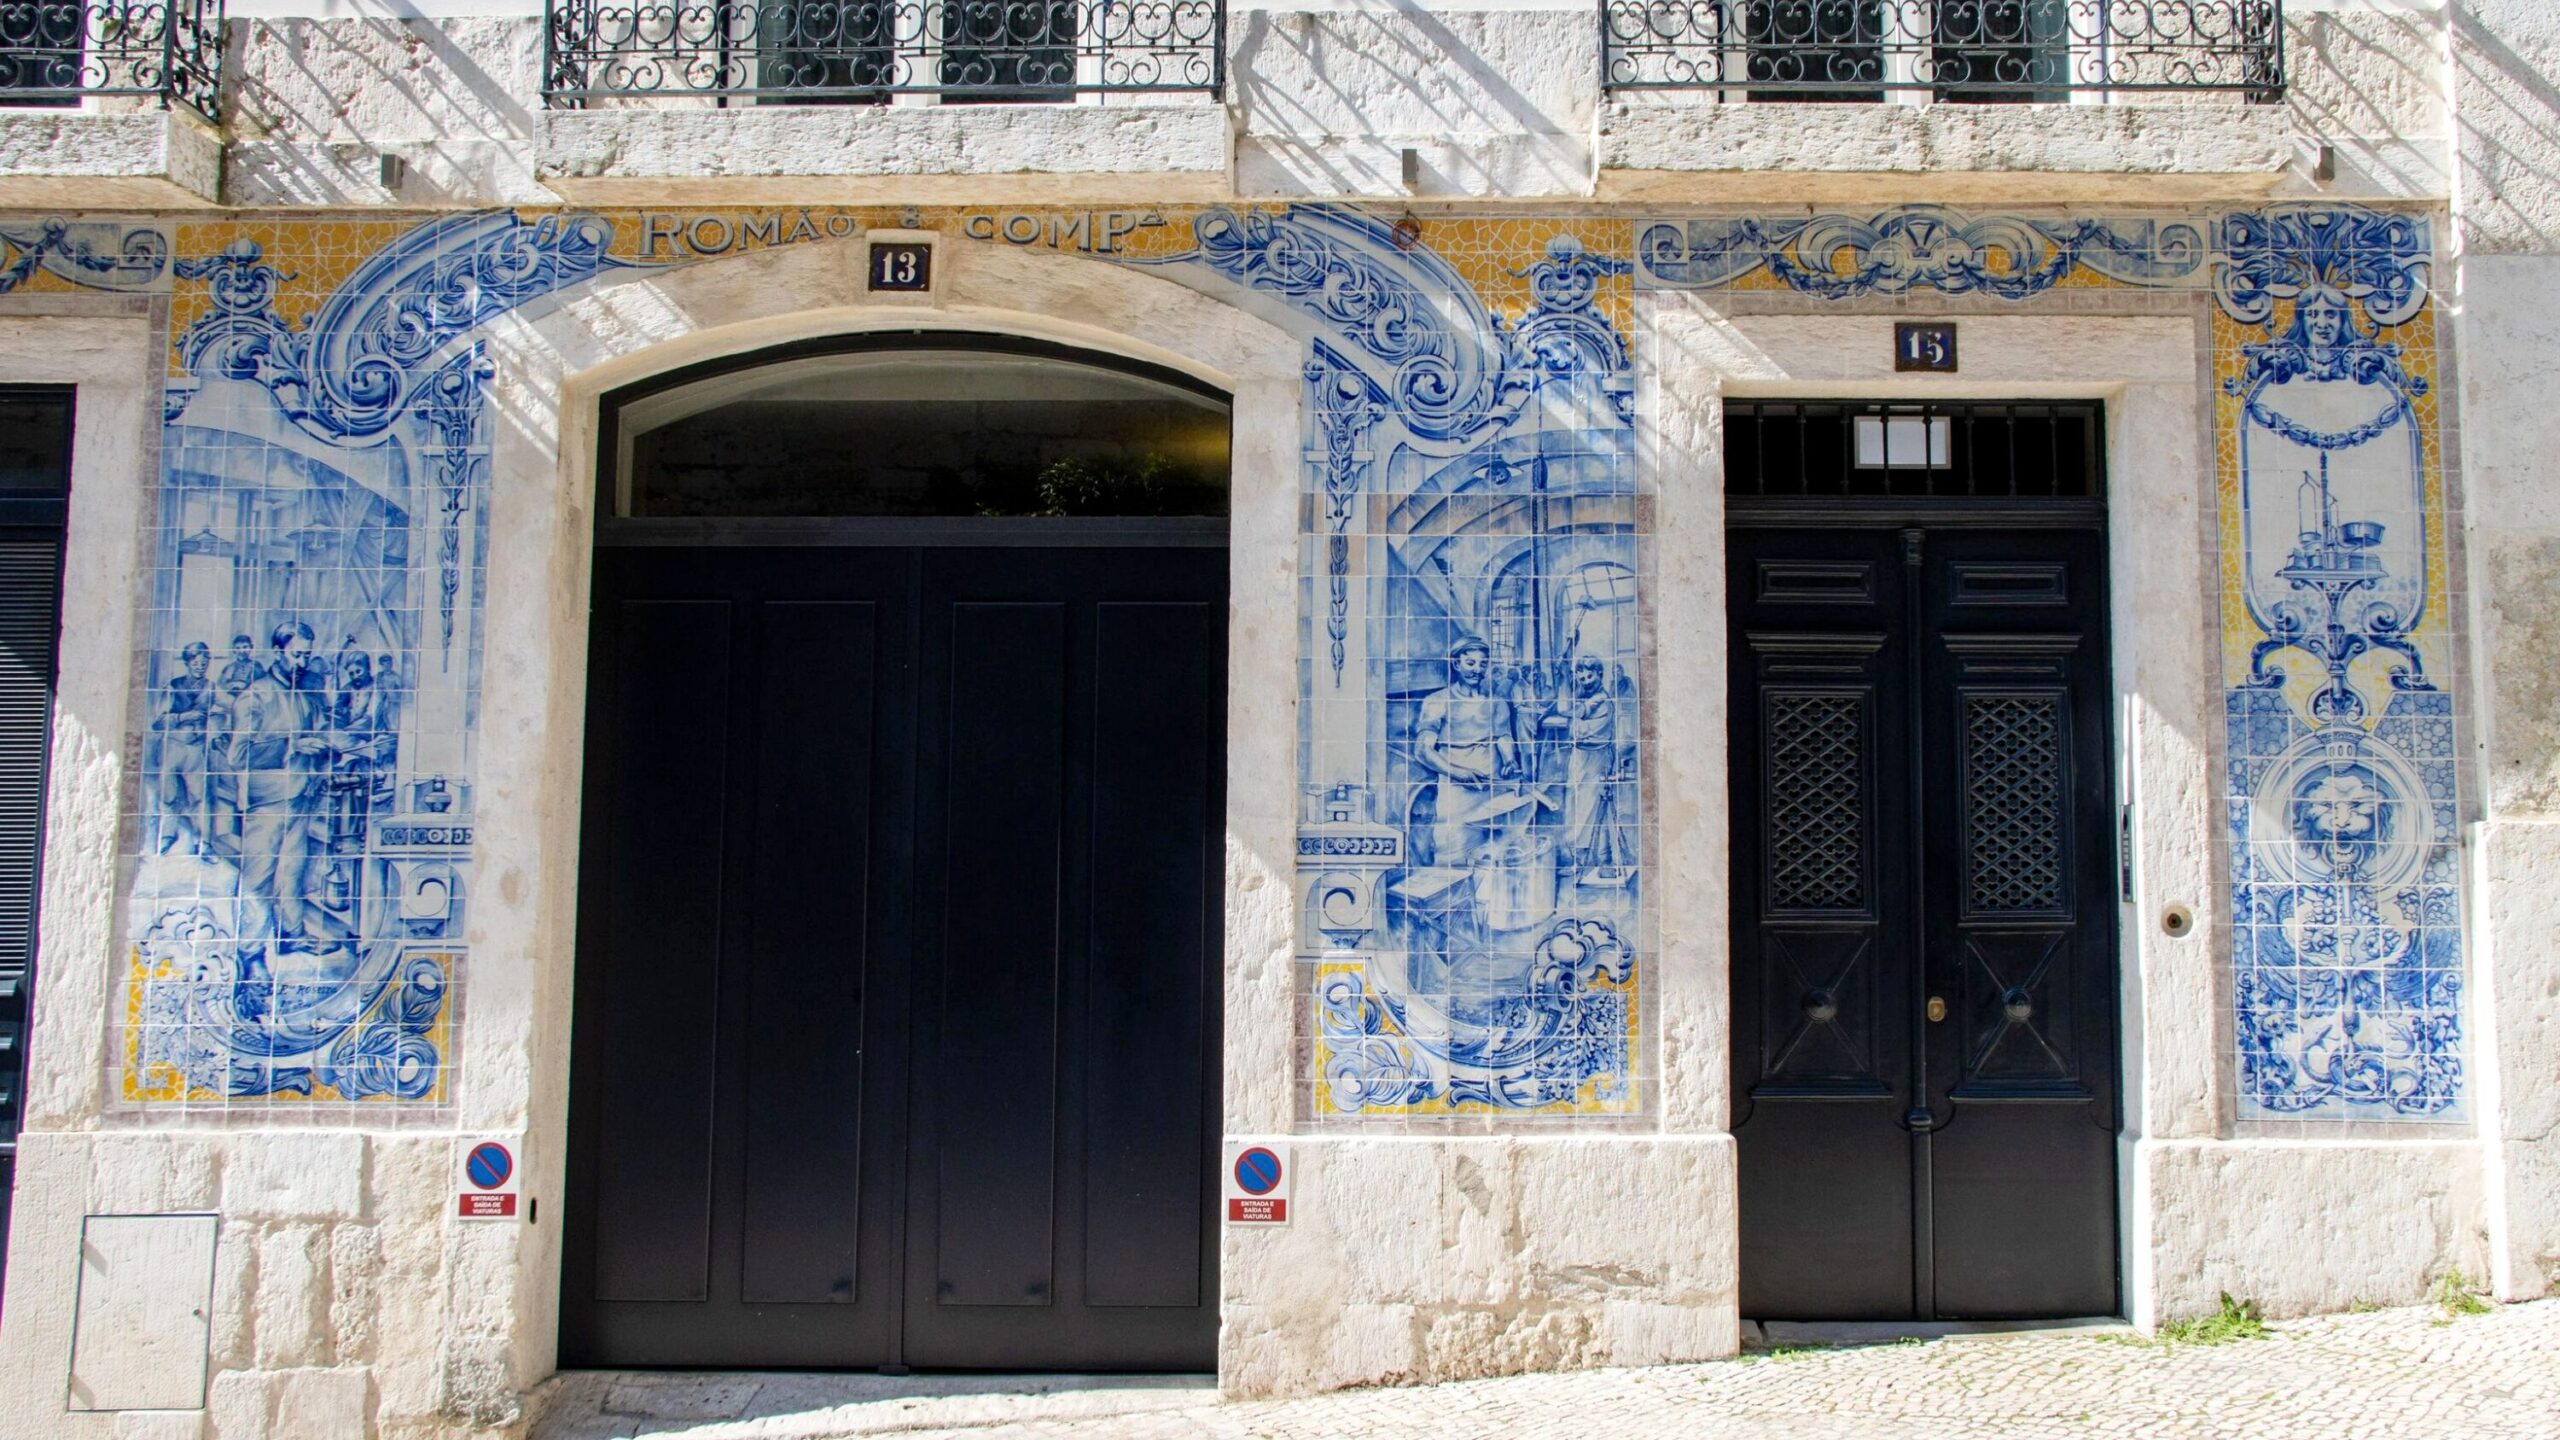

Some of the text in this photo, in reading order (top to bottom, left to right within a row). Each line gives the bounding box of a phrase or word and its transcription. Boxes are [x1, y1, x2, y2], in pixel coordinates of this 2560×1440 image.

[637, 209, 855, 259] ROMÃO
[901, 204, 920, 228] &
[882, 251, 916, 283] 13
[1909, 331, 1944, 363] 15
